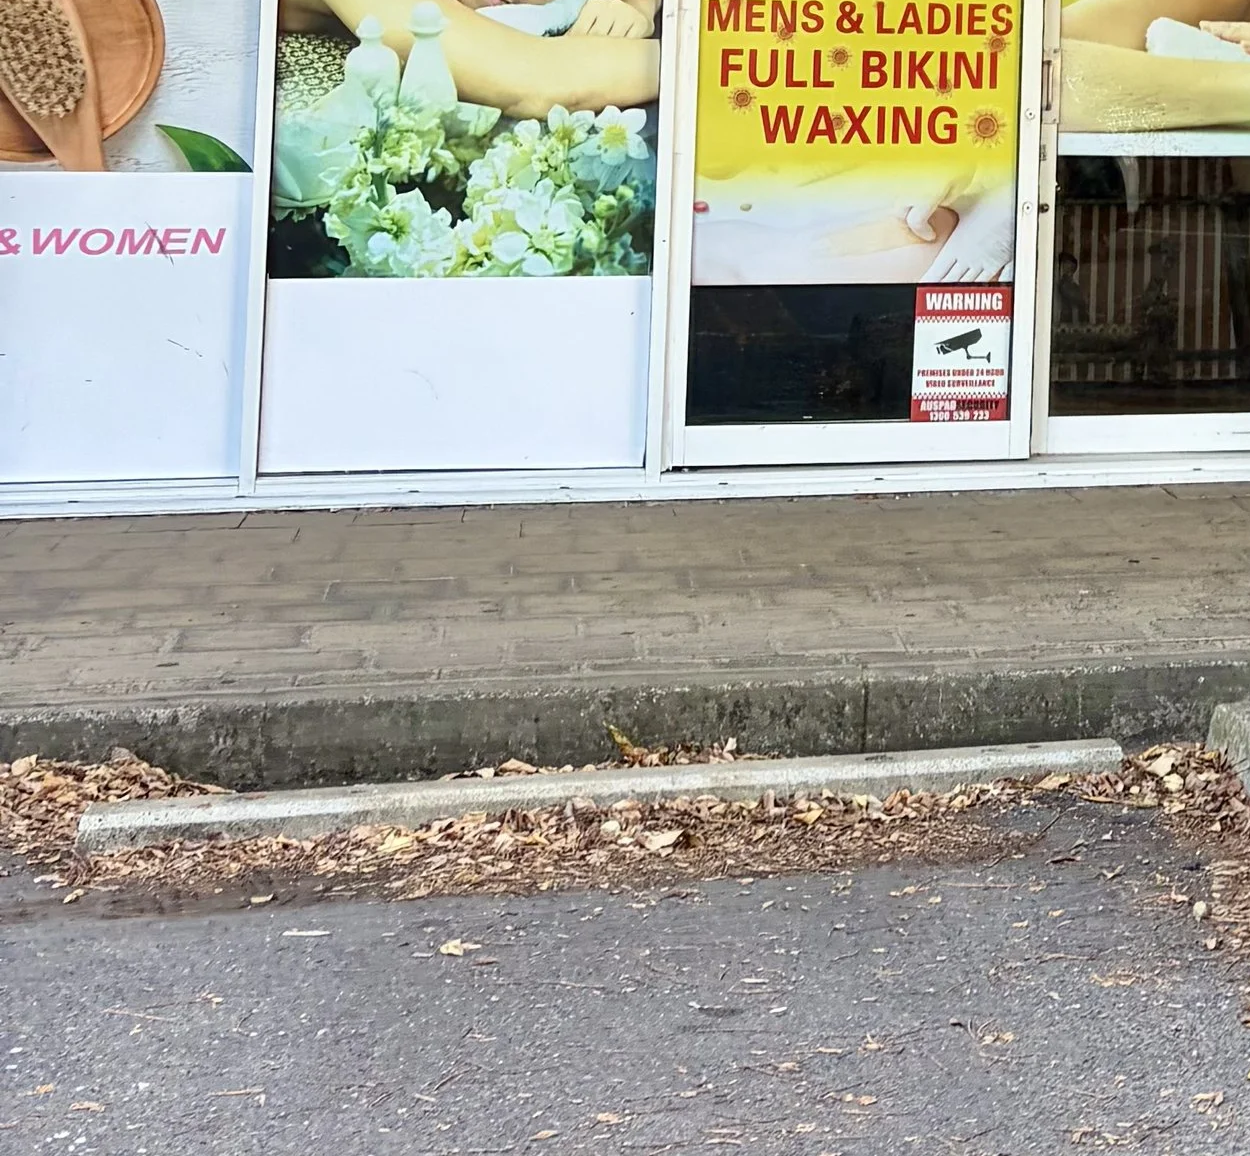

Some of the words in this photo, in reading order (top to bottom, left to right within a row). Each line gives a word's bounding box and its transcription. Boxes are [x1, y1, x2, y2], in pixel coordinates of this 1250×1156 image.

[836, 0, 864, 34] &
[876, 1, 1014, 36] LADIES
[720, 48, 835, 88] FULL
[861, 50, 998, 89] BIKINI
[759, 104, 958, 144] WAXING
[33, 228, 227, 255] WOMEN
[925, 292, 1003, 311] WARNING
[917, 369, 950, 378] PREMISES
[952, 368, 975, 377] UNDER
[976, 368, 985, 377] 24
[926, 380, 946, 388] VIDEO
[947, 379, 995, 388] SURVEILLANCE
